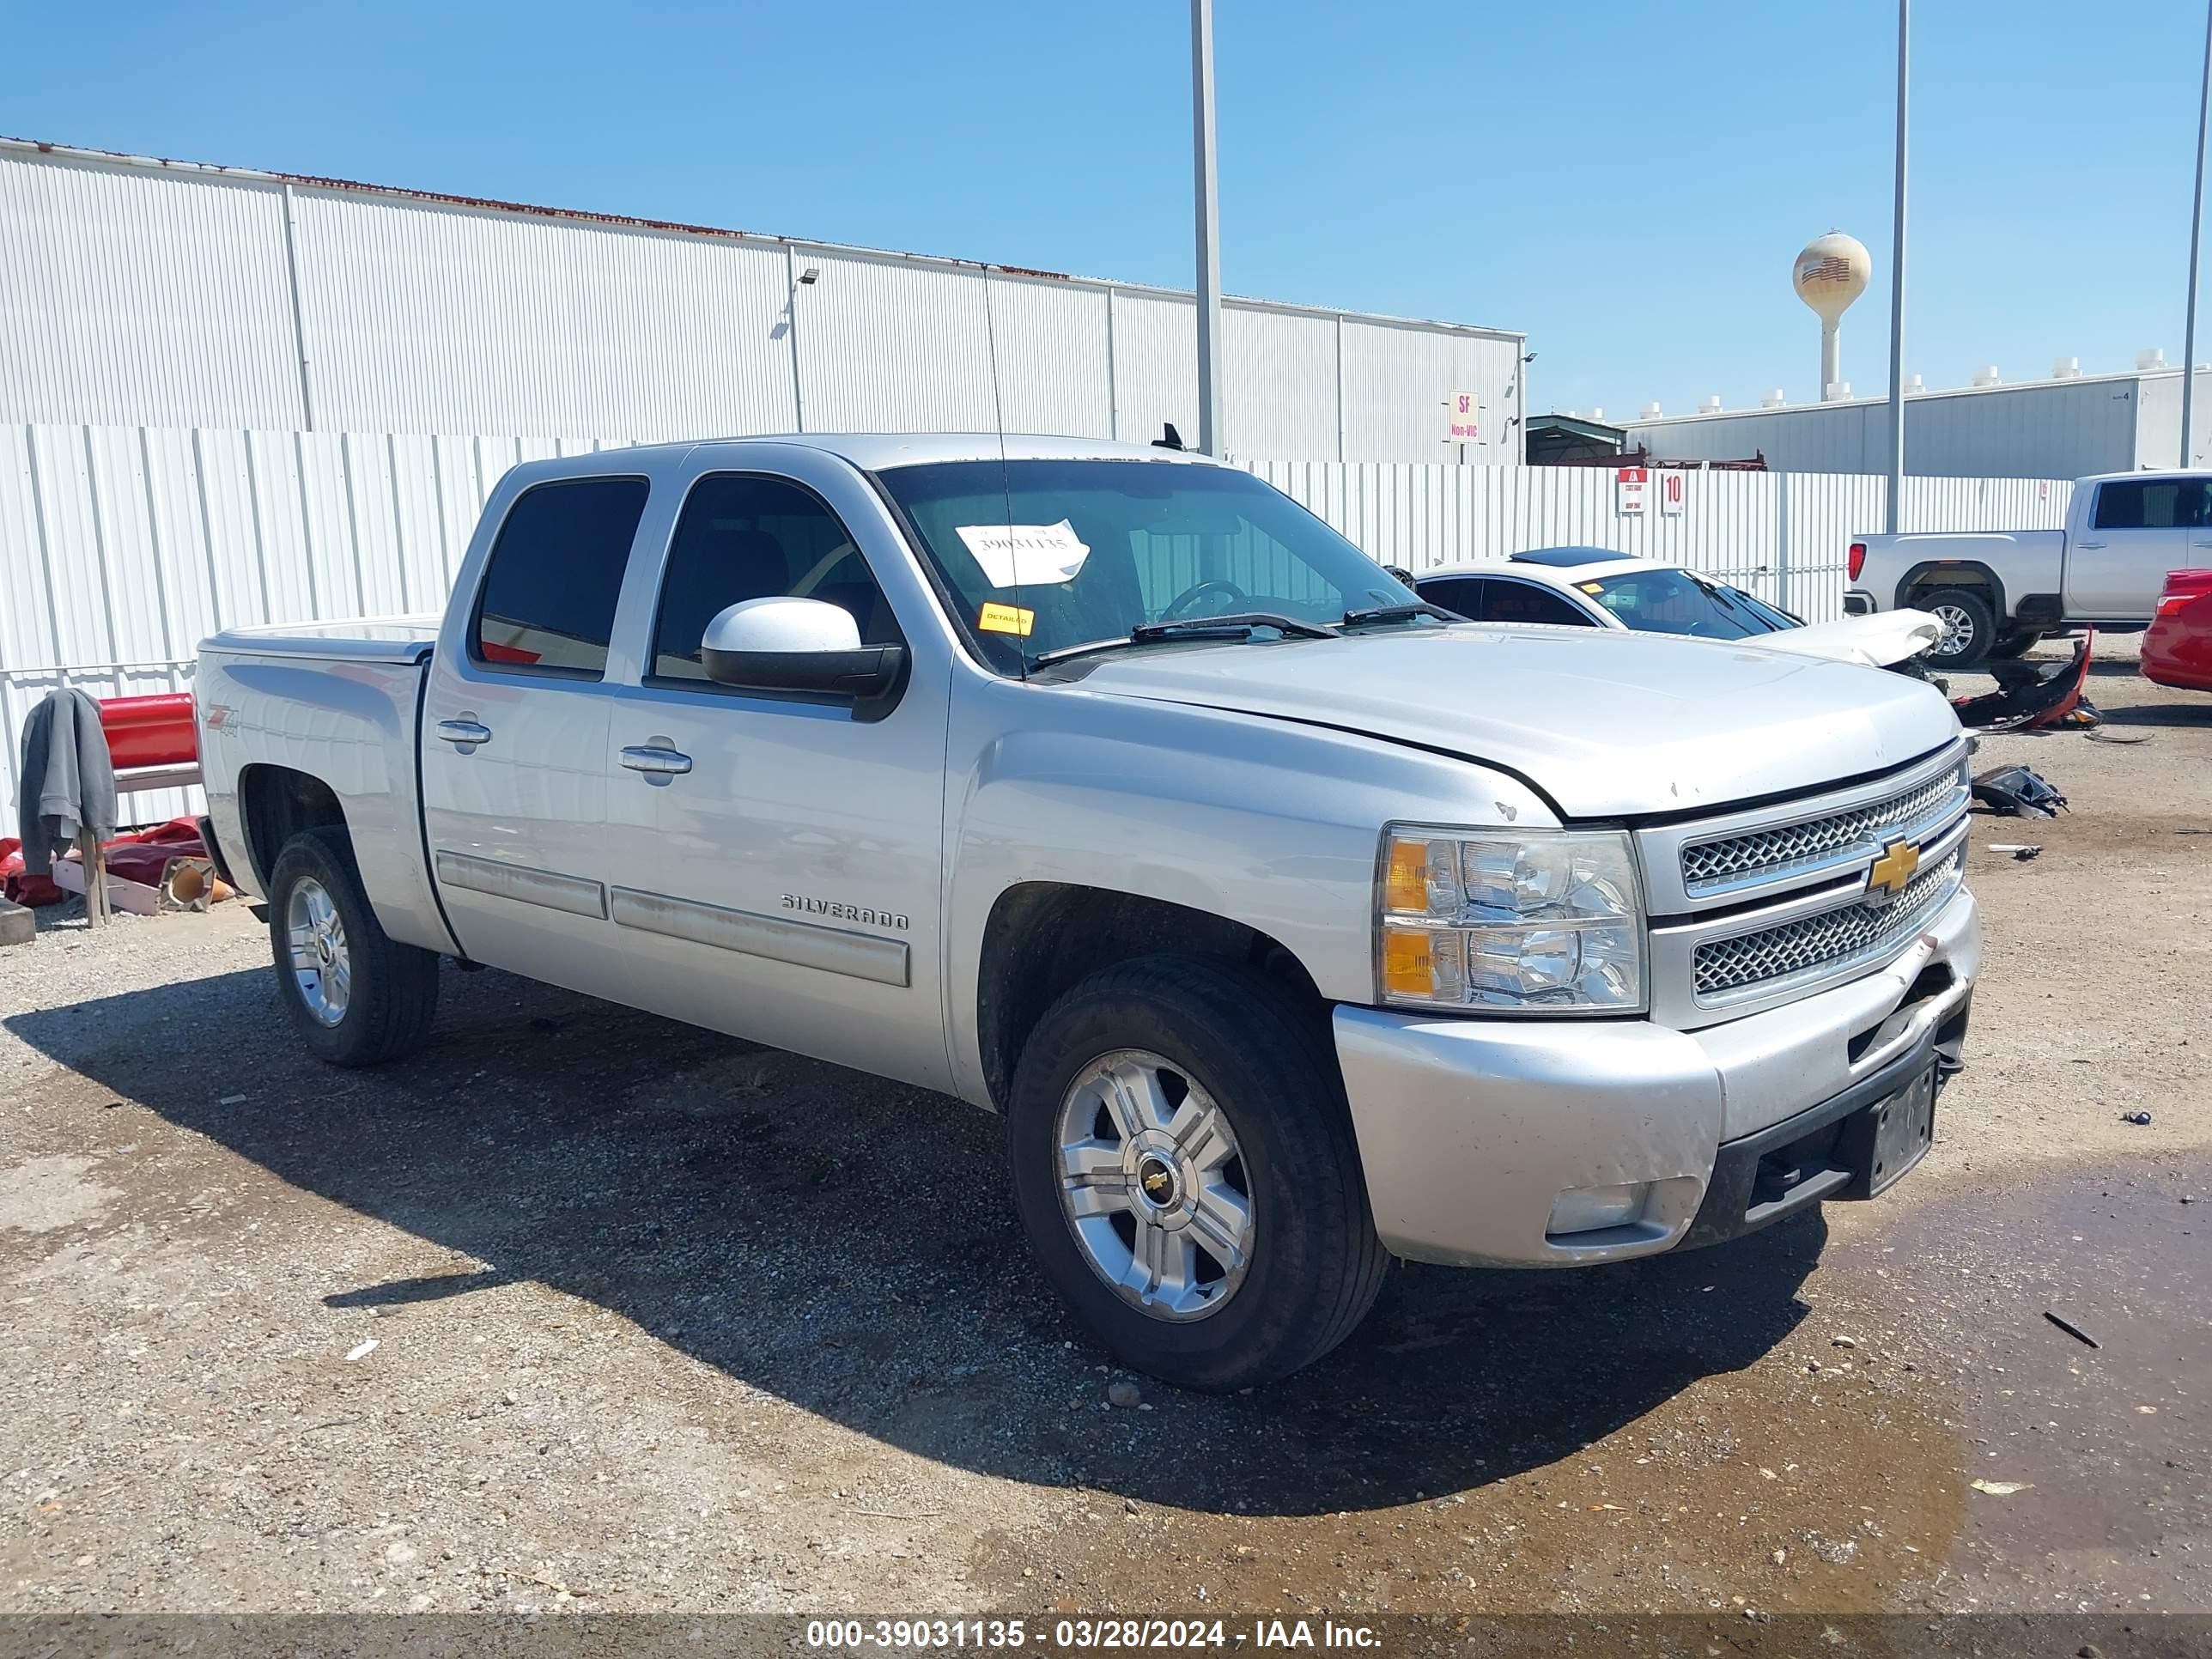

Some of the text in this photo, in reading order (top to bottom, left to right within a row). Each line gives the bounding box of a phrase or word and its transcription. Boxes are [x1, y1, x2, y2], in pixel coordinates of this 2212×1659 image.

[1459, 395, 1471, 413] SF
[1451, 423, 1478, 437] Non-VIC
[1666, 475, 1680, 502] 10
[979, 538, 1067, 550] 39031135
[987, 613, 1027, 623] DETAILED
[781, 893, 909, 930] SILVERADO
